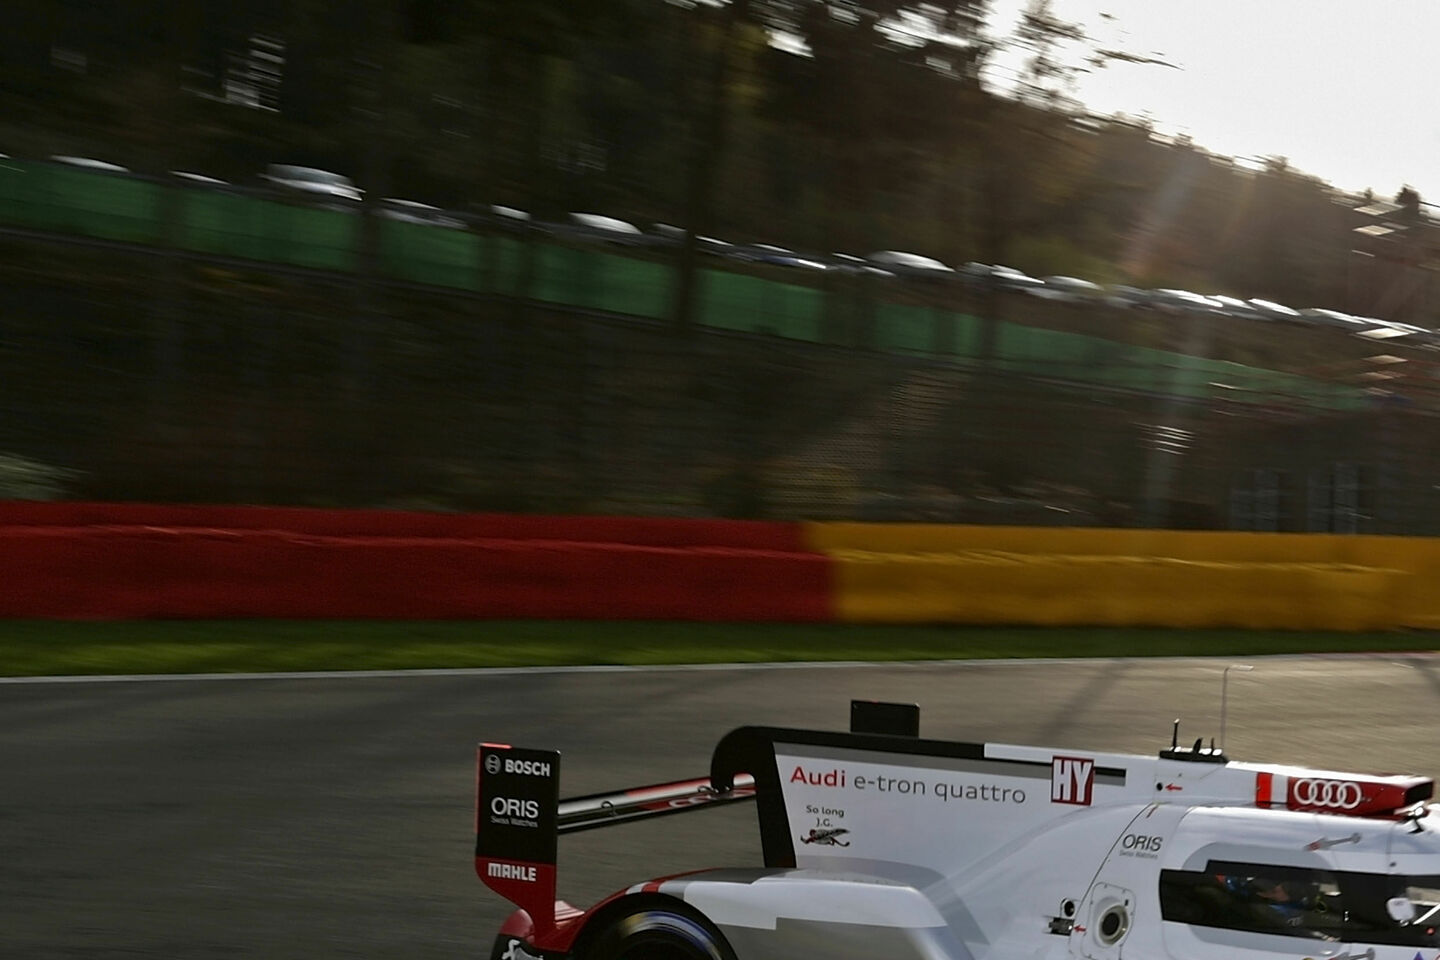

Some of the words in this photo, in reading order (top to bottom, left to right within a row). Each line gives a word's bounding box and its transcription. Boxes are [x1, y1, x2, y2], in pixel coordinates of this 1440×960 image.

[505, 759, 551, 777] BOSCH
[790, 766, 846, 788] Audi
[854, 774, 926, 795] e-tron
[934, 782, 1027, 804] quattro
[1053, 759, 1093, 803] HY
[491, 797, 539, 819] ORIS
[806, 804, 819, 815] So
[821, 806, 845, 818] long
[816, 818, 834, 827] J.G.
[1122, 834, 1163, 852] ORIS
[488, 862, 537, 881] MAHLE
